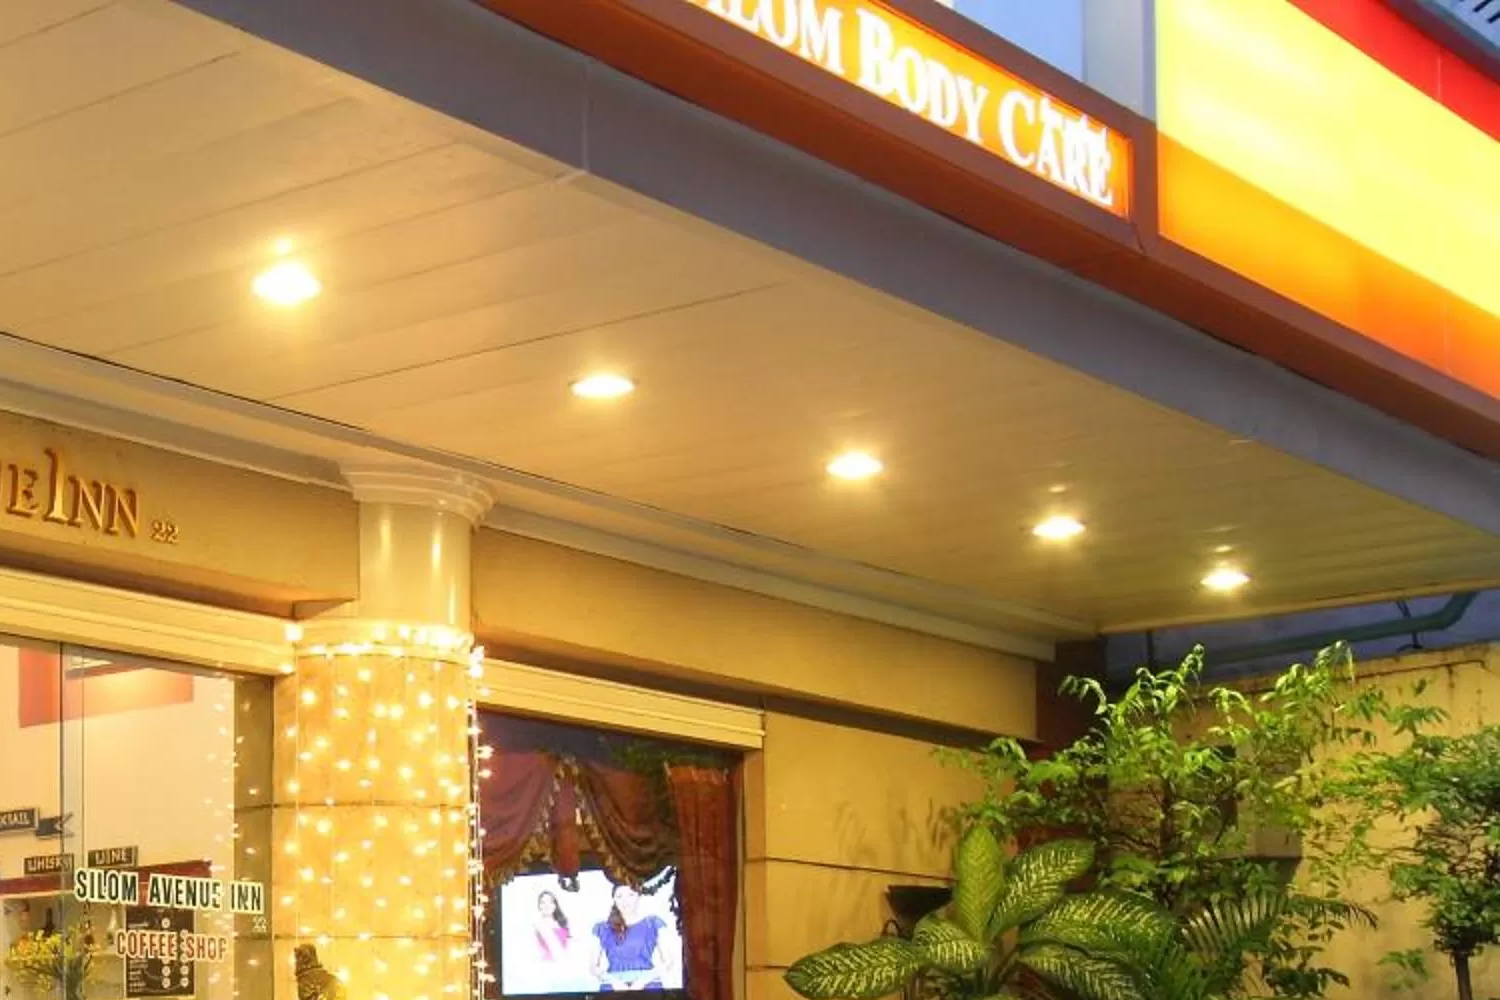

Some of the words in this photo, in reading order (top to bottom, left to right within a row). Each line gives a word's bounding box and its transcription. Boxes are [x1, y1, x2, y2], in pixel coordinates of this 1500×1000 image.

[857, 7, 990, 146] BODY
[999, 90, 1113, 206] CARE
[42, 446, 141, 538] INN
[76, 870, 138, 901] SILOM
[149, 877, 221, 909] AVENUE
[231, 883, 262, 911] INN
[116, 930, 176, 957] COFFEE
